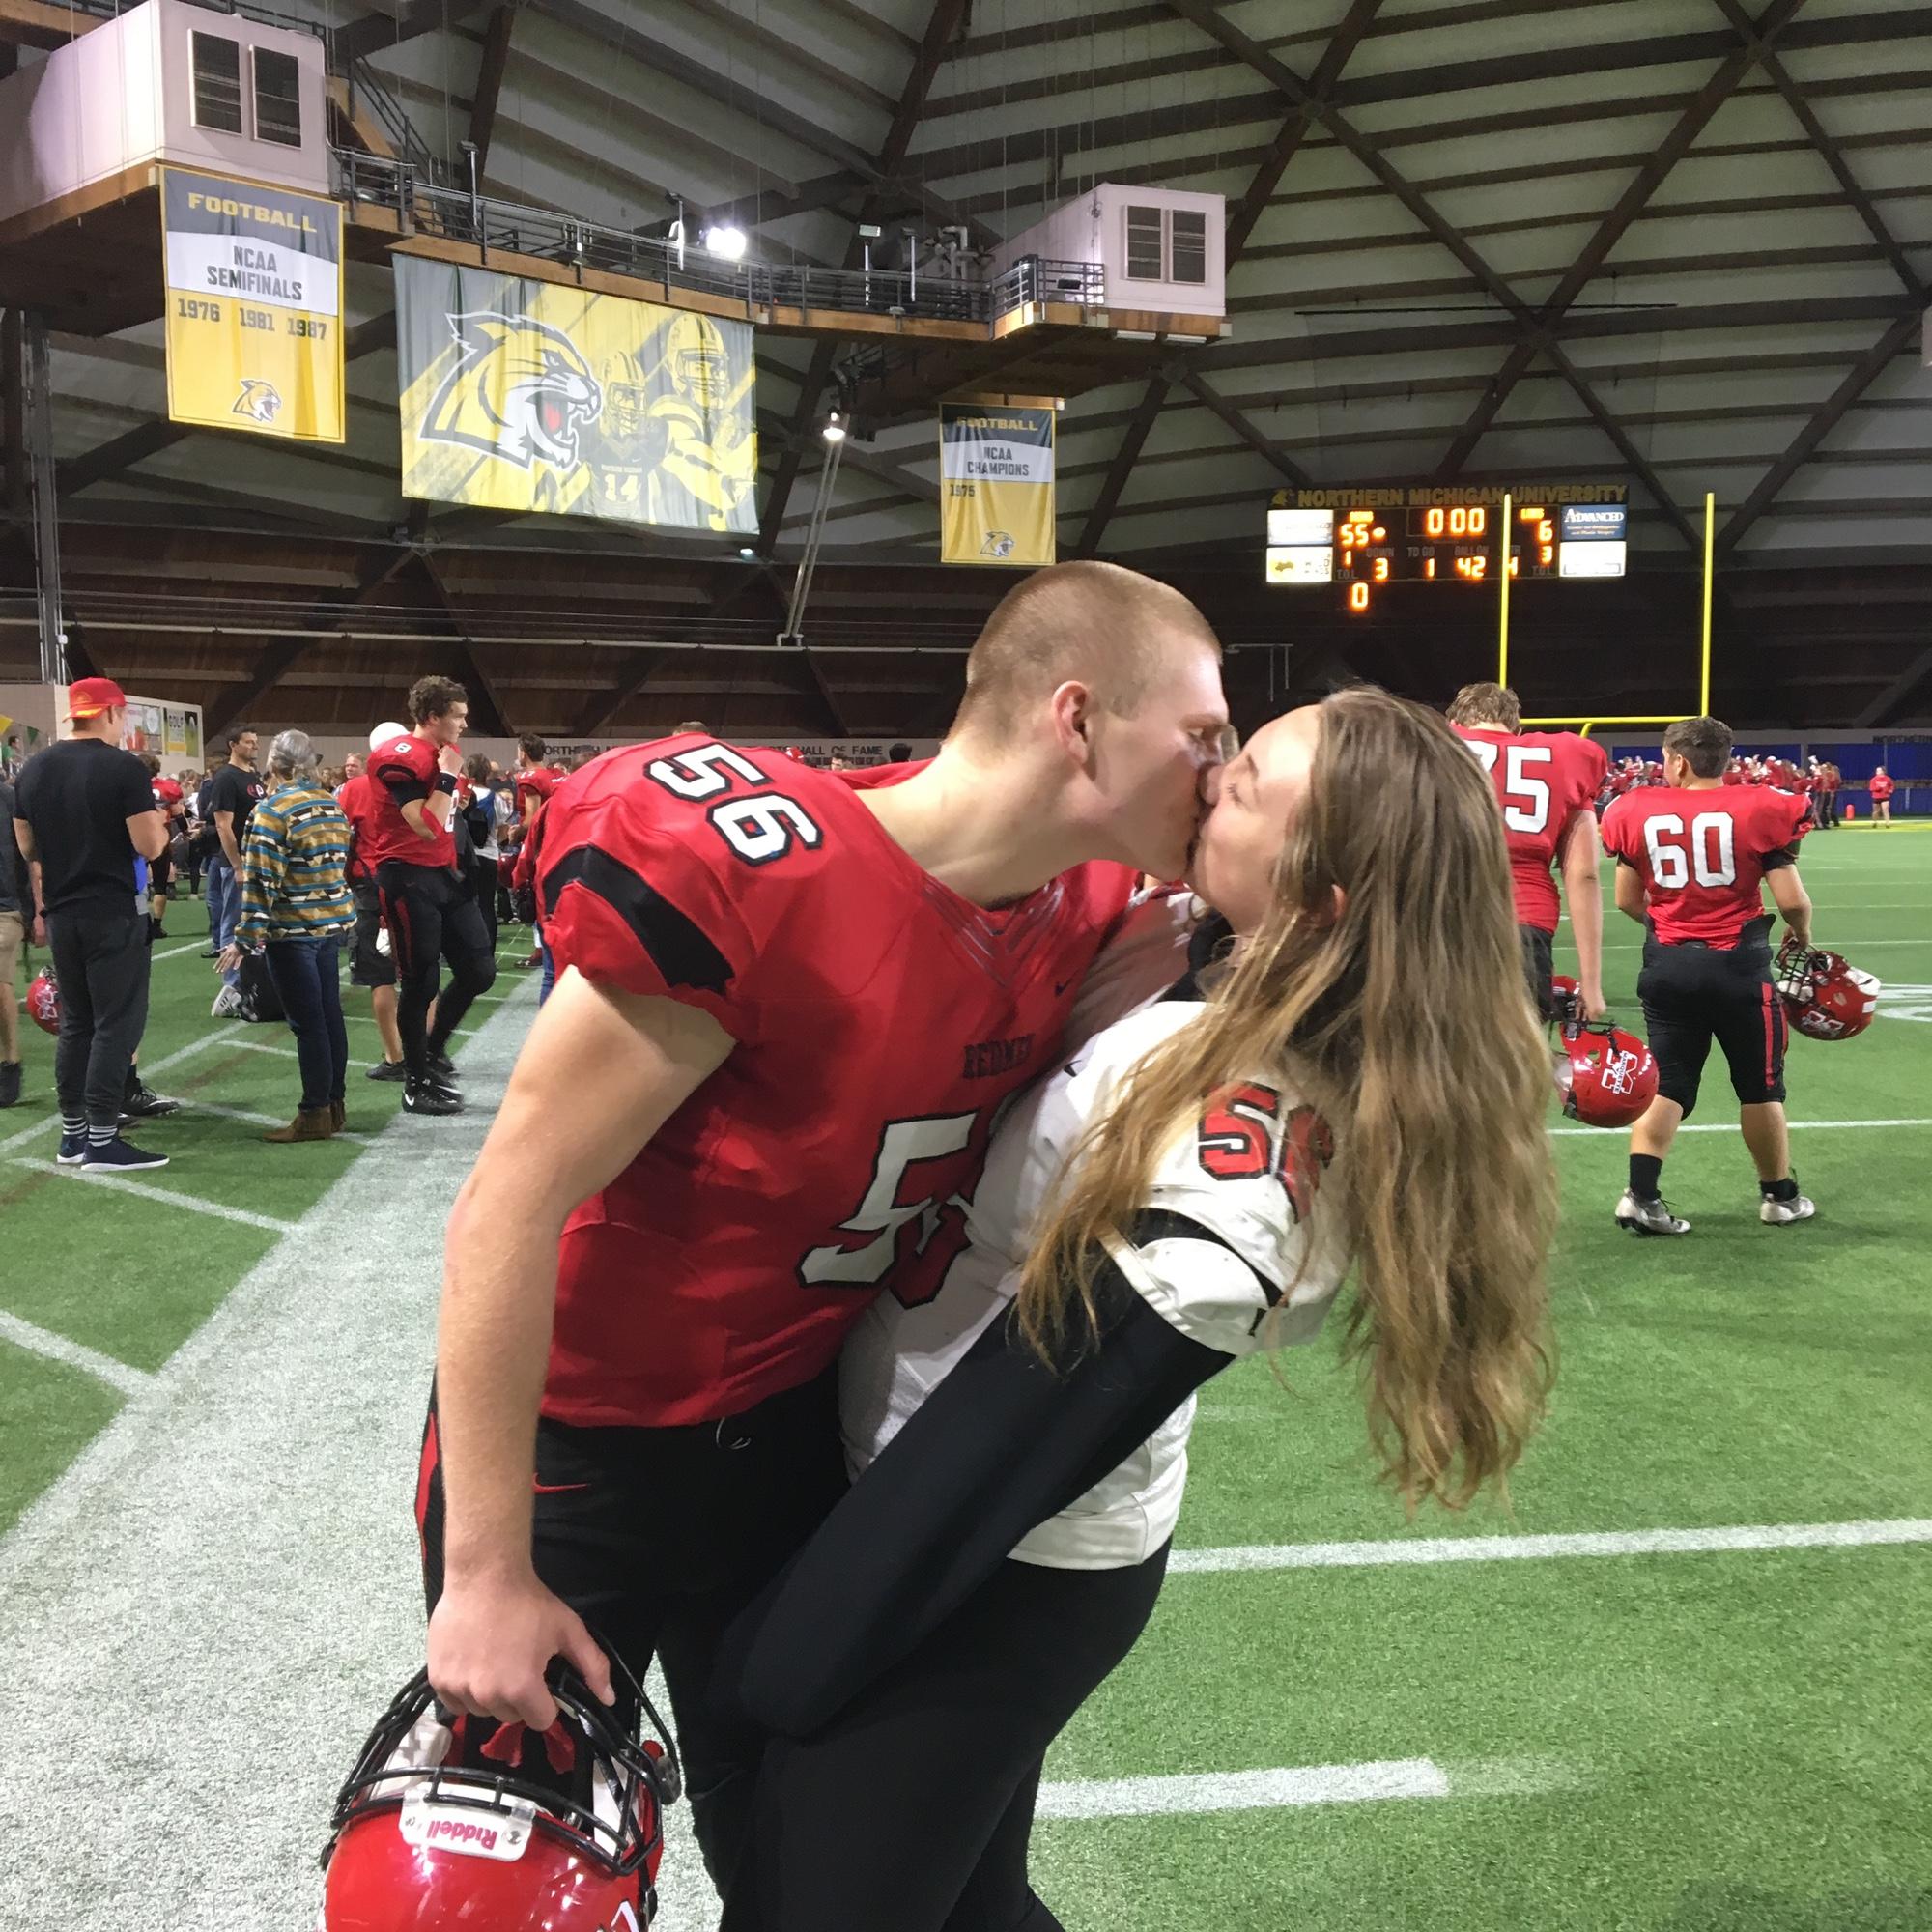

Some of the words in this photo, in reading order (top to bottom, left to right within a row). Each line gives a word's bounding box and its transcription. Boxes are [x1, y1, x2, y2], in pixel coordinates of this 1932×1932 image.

[188, 192, 318, 233] FOOTBALL
[233, 245, 278, 272] NCAA
[207, 265, 302, 300] SEMIFINALS
[178, 298, 220, 322] 1976
[240, 307, 275, 331] 1981
[287, 318, 327, 340] 1987
[956, 416, 1038, 431] FOOTBALL
[983, 447, 1012, 461] NCAA
[967, 461, 1030, 476] CHAMPIONS
[950, 484, 976, 497] 1975
[1297, 489, 1404, 507] NORTHERN
[1409, 487, 1505, 505] MICHIGAN
[1511, 485, 1629, 503] UNIVERSITY
[1341, 523, 1369, 546] 55
[1538, 519, 1553, 542] 6
[1540, 545, 1553, 563] 3
[1375, 556, 1389, 580] 3
[1427, 557, 1435, 577] 1
[1456, 555, 1487, 578] 42
[1351, 582, 1370, 609] 0
[852, 745, 884, 755] FAME
[643, 740, 825, 867] 56
[1642, 810, 1737, 889] 60
[426, 1820, 498, 1850] Riddell
